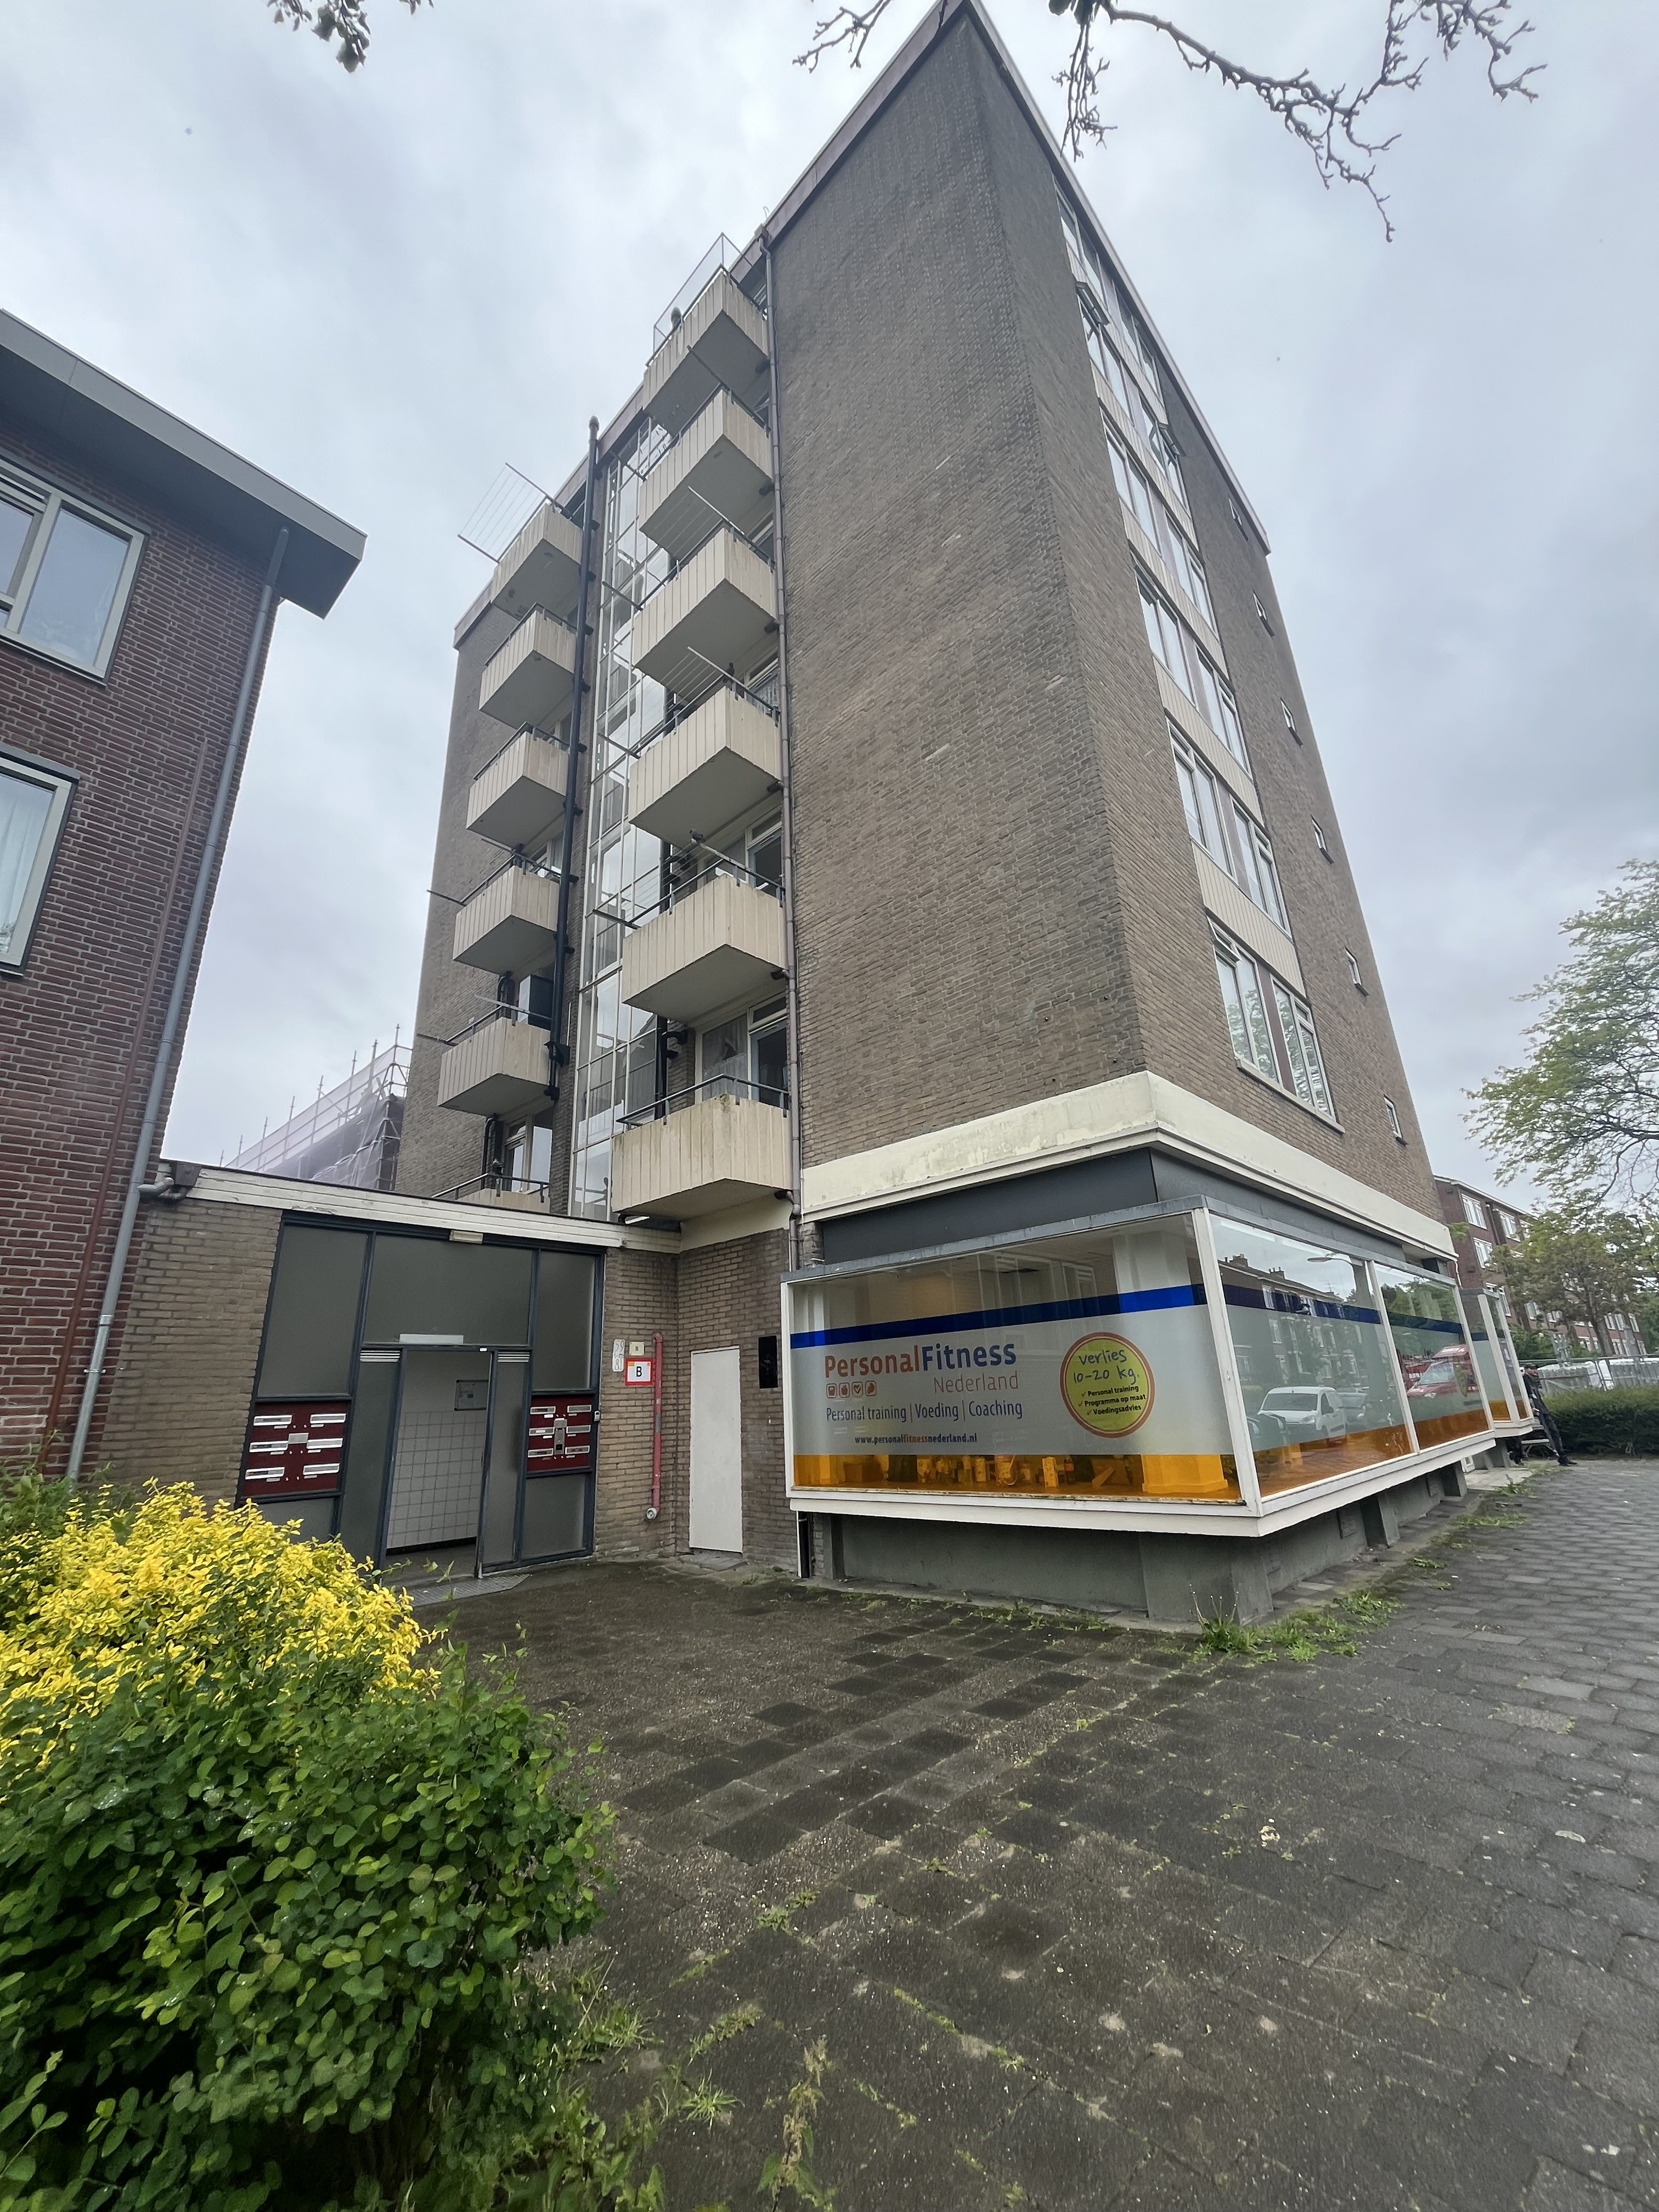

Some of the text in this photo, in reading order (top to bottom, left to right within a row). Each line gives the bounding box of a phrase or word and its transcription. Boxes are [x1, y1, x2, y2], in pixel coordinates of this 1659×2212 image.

[614, 1340, 625, 1352] 59
[825, 1343, 1017, 1378] PersonalFitness
[636, 1366, 642, 1377] B
[1073, 1369, 1110, 1384] 10-20
[934, 1370, 1019, 1393] Nederland
[1087, 1385, 1139, 1397] Personal training
[1084, 1397, 1120, 1407] Programma
[826, 1399, 1023, 1423] Personal training Voeding Coaching
[1092, 1404, 1142, 1415] Voedingsadvies
[854, 1432, 978, 1445] www.personalfitnessnederland.nl
